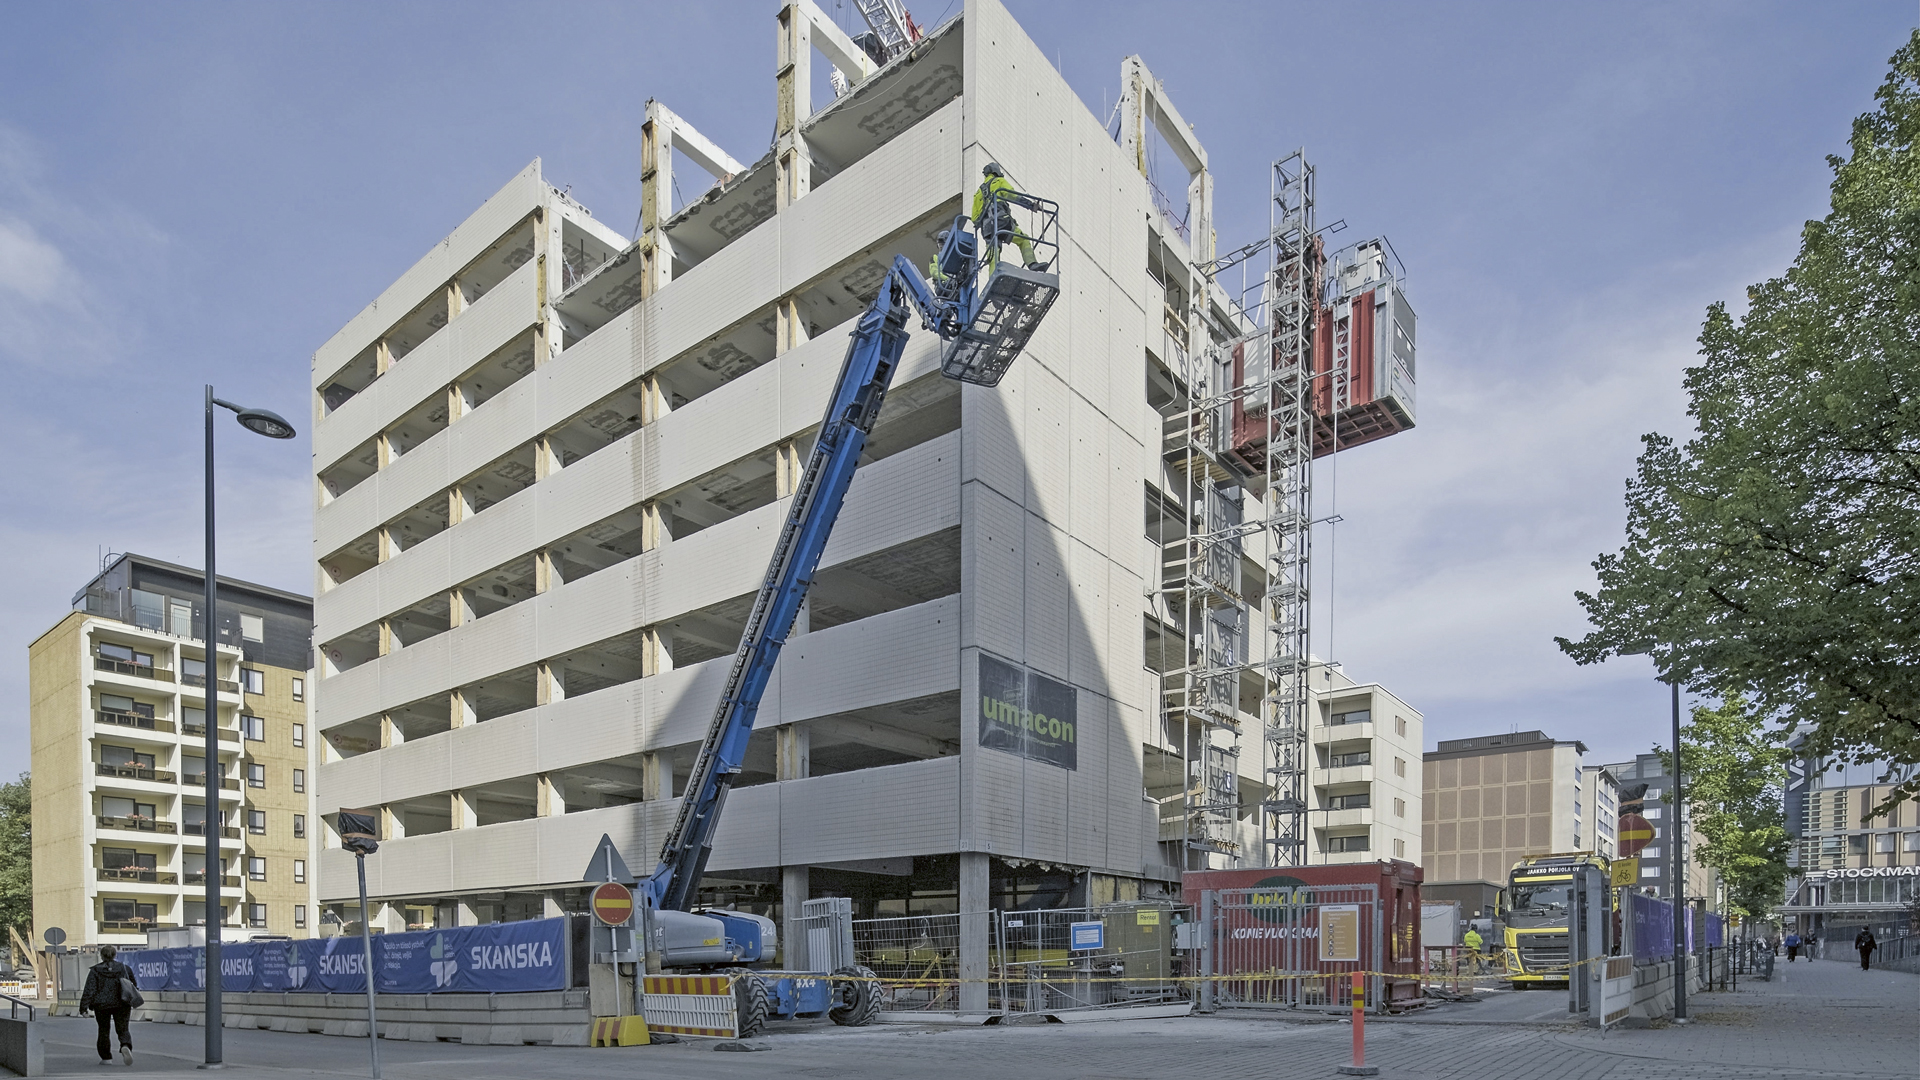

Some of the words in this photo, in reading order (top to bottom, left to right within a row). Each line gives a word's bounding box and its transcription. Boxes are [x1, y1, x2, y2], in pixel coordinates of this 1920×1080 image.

[983, 695, 1074, 743] umacon
[319, 953, 366, 975] SKANSK
[470, 941, 553, 970] SKANSKA
[138, 961, 168, 978] SKANSKA
[220, 958, 254, 976] KANSKA
